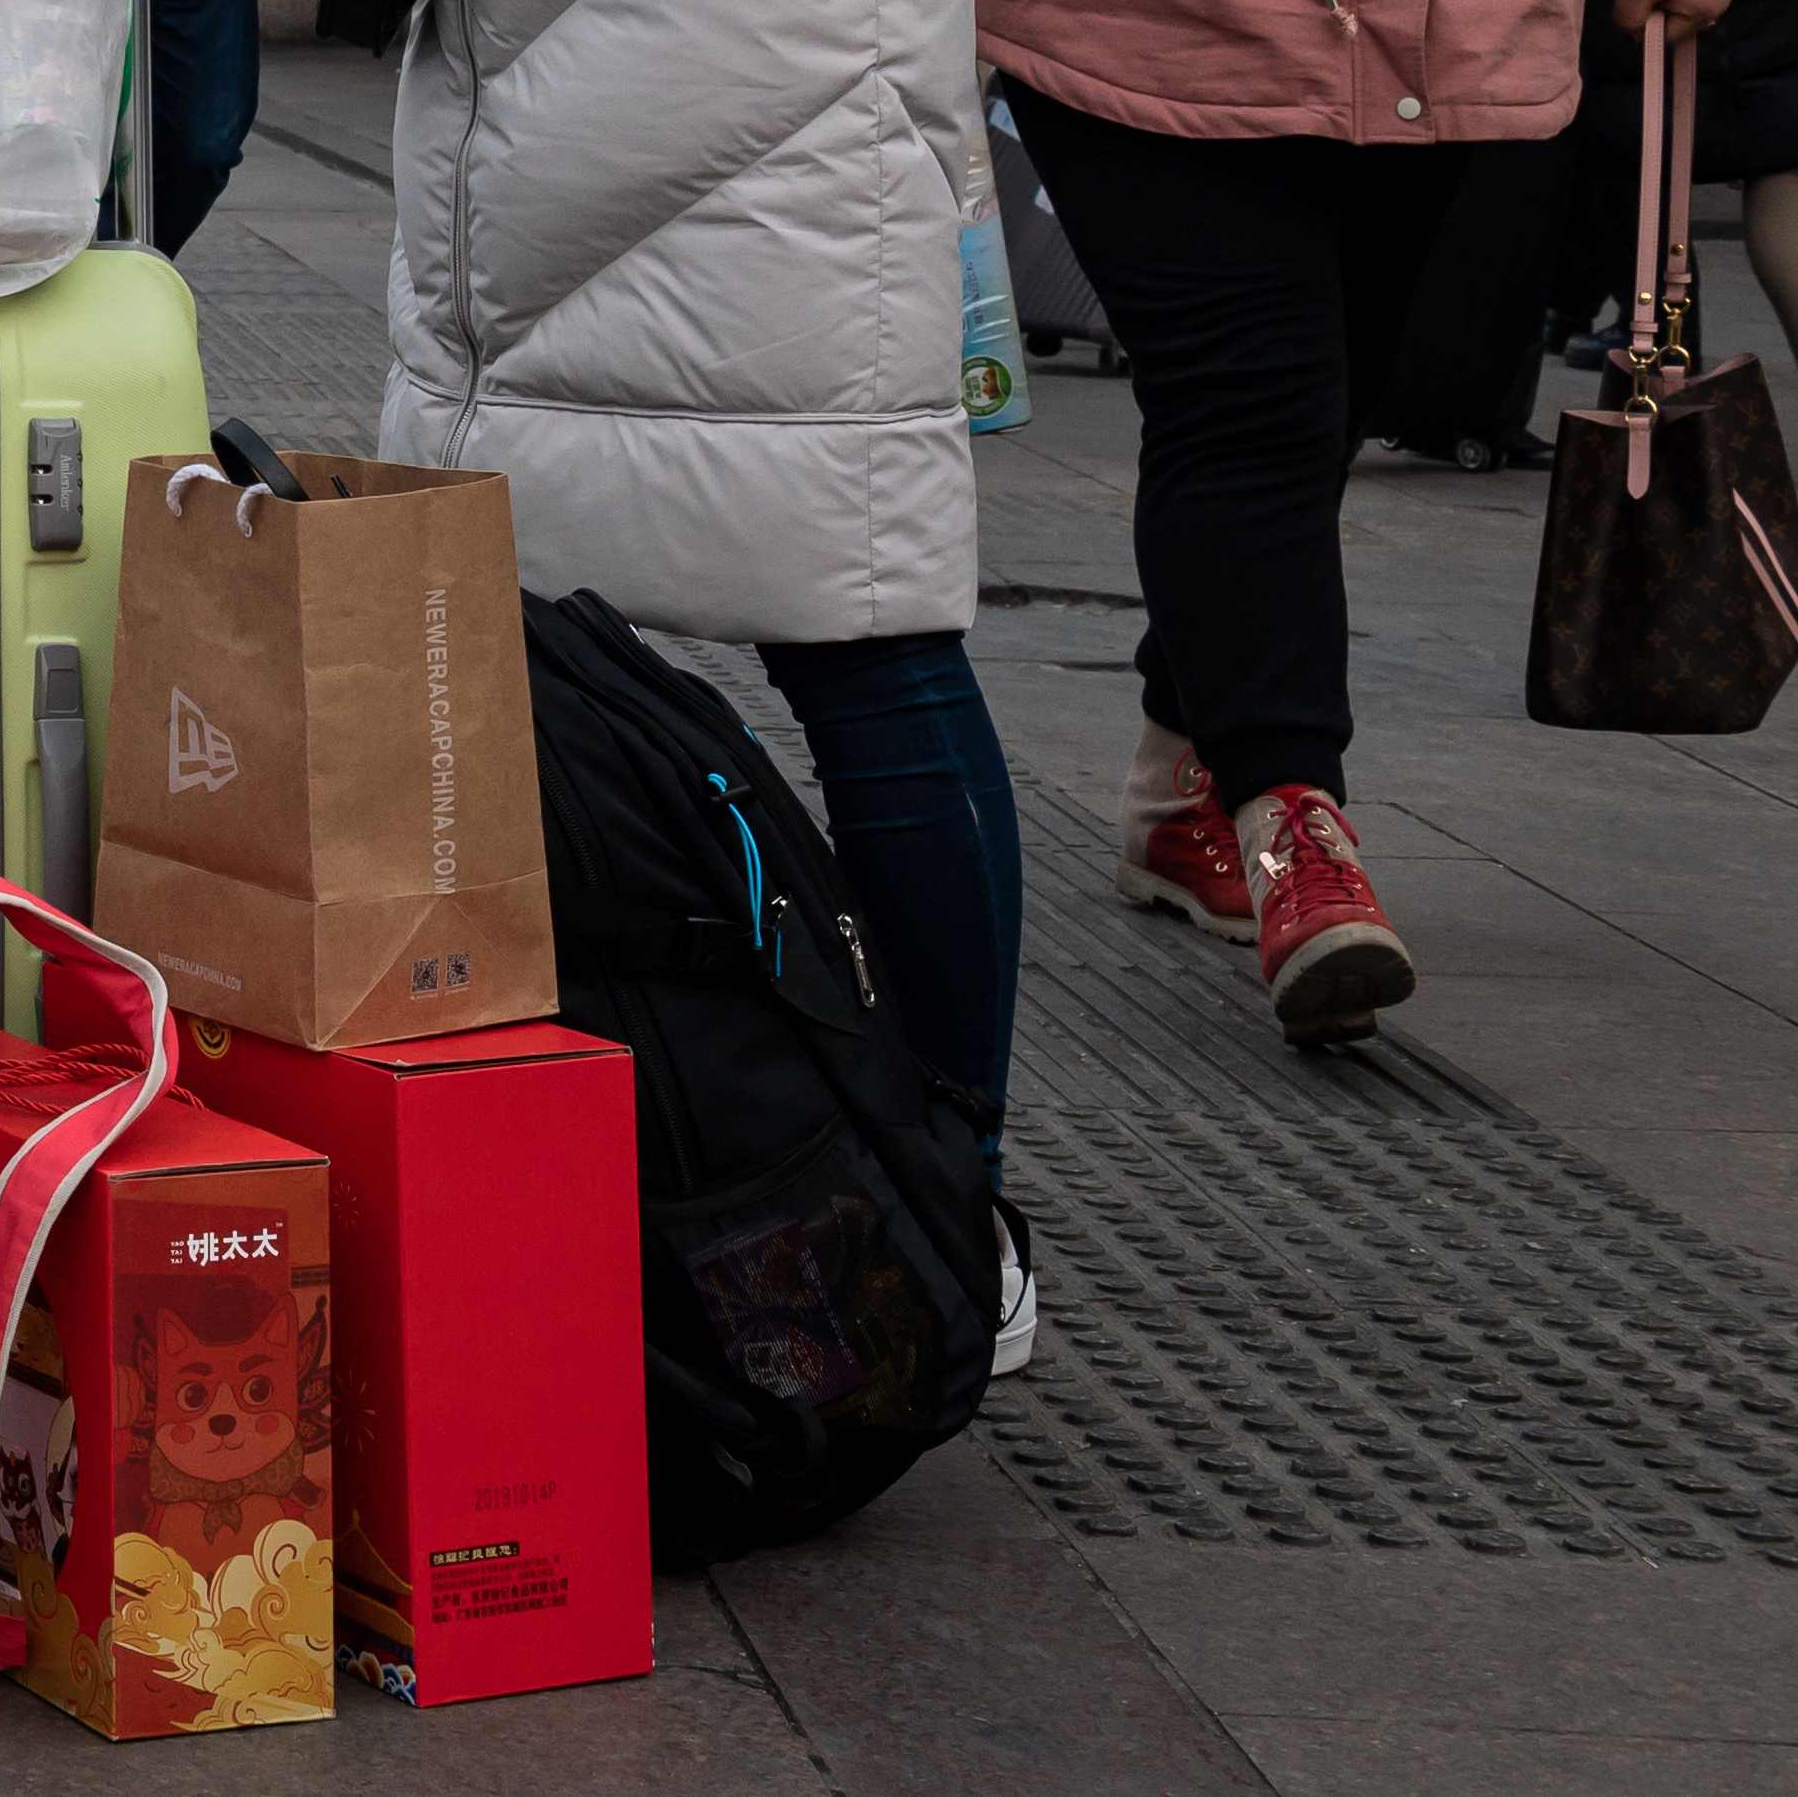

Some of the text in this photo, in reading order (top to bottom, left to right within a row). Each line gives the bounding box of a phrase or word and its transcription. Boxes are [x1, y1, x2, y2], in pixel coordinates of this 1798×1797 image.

[425, 588, 456, 896] NEWERACAPCHINA.COM
[187, 1228, 280, 1267] 姚太太
